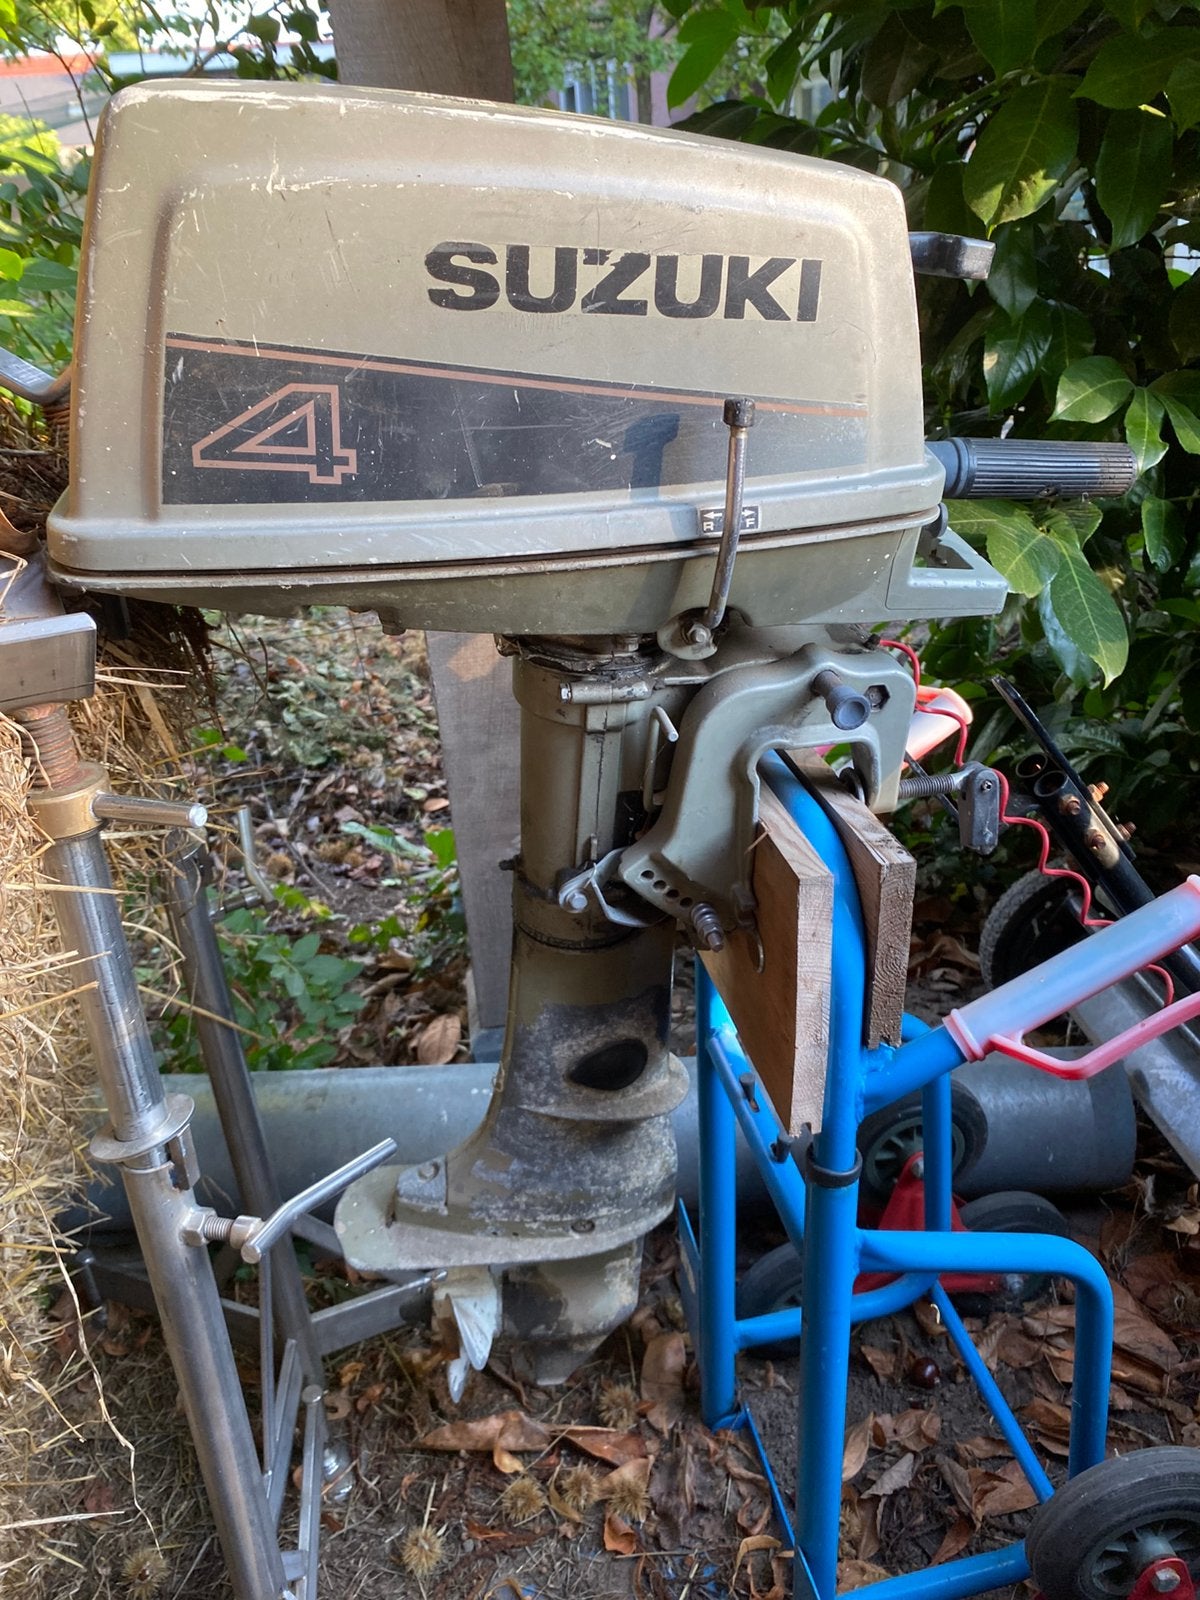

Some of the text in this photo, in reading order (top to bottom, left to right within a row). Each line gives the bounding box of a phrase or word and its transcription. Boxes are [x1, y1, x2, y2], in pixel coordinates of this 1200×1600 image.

[424, 241, 822, 322] SUZUKI
[192, 382, 357, 485] 4
[703, 518, 755, 532] R F
